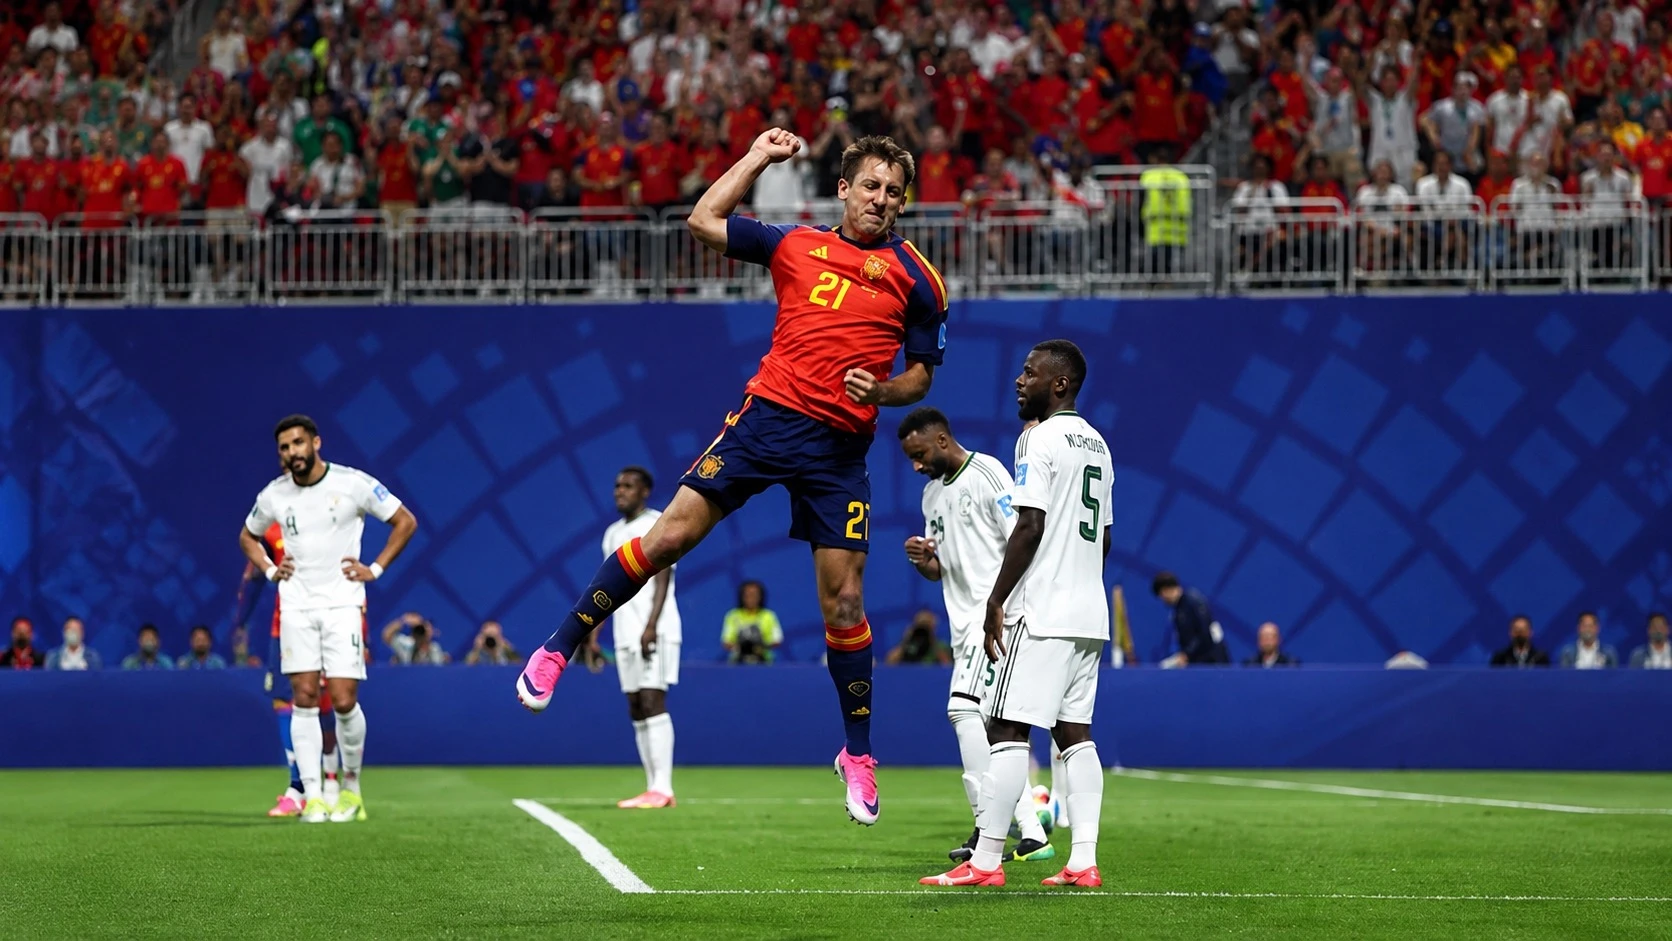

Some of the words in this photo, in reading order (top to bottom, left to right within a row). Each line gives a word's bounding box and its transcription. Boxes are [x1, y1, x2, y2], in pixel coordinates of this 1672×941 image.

[809, 271, 851, 310] 21
[1079, 464, 1102, 543] 5
[286, 516, 298, 536] 4
[351, 633, 360, 656] 4
[985, 660, 996, 687] 5
